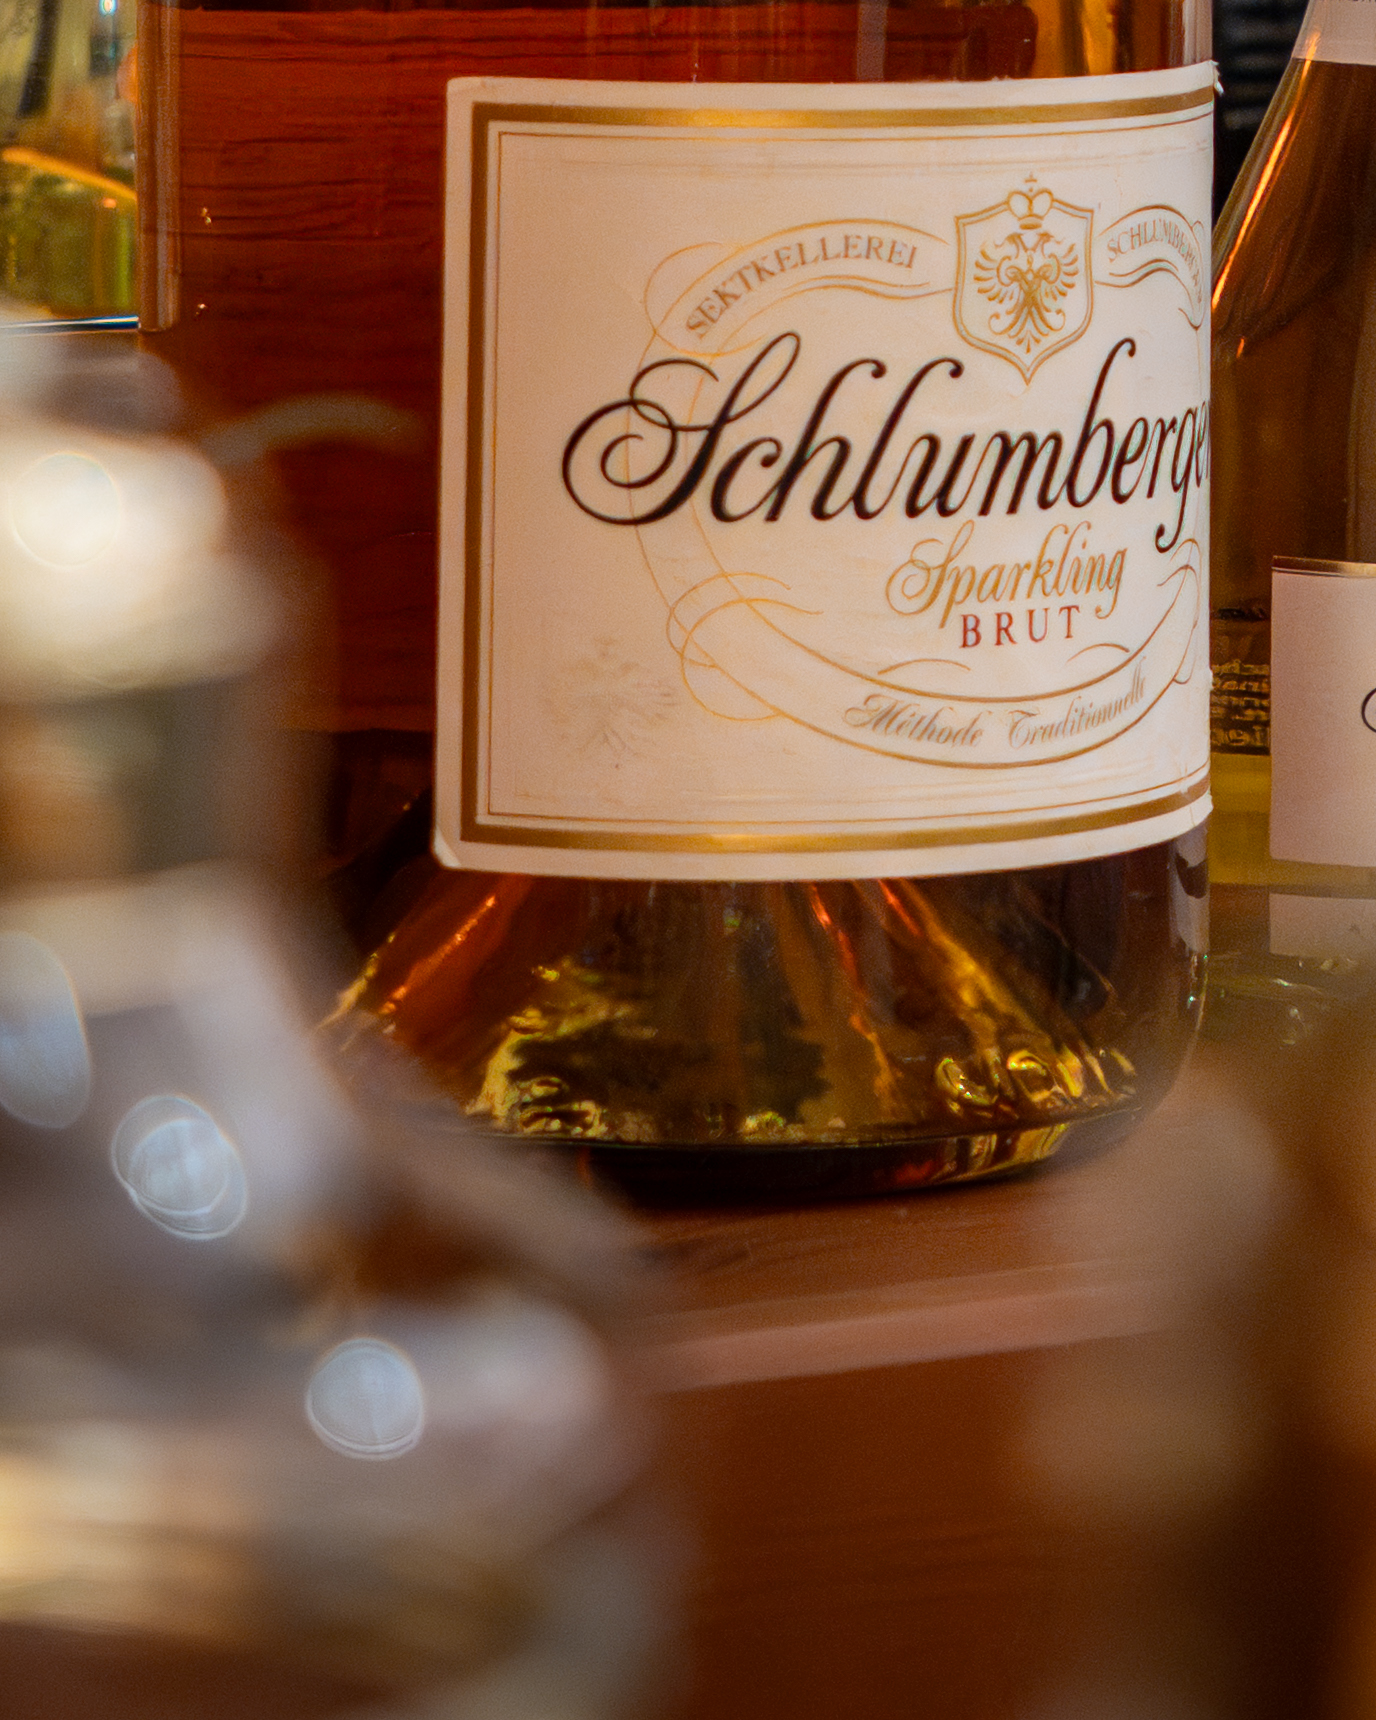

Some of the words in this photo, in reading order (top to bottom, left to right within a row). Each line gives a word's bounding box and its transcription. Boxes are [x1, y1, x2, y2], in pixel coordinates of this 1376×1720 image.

[685, 233, 918, 340] SEKTKELLEREI
[884, 518, 1128, 630] Sparkling
[958, 604, 1081, 649] BRUT
[841, 693, 994, 748] Méthode
